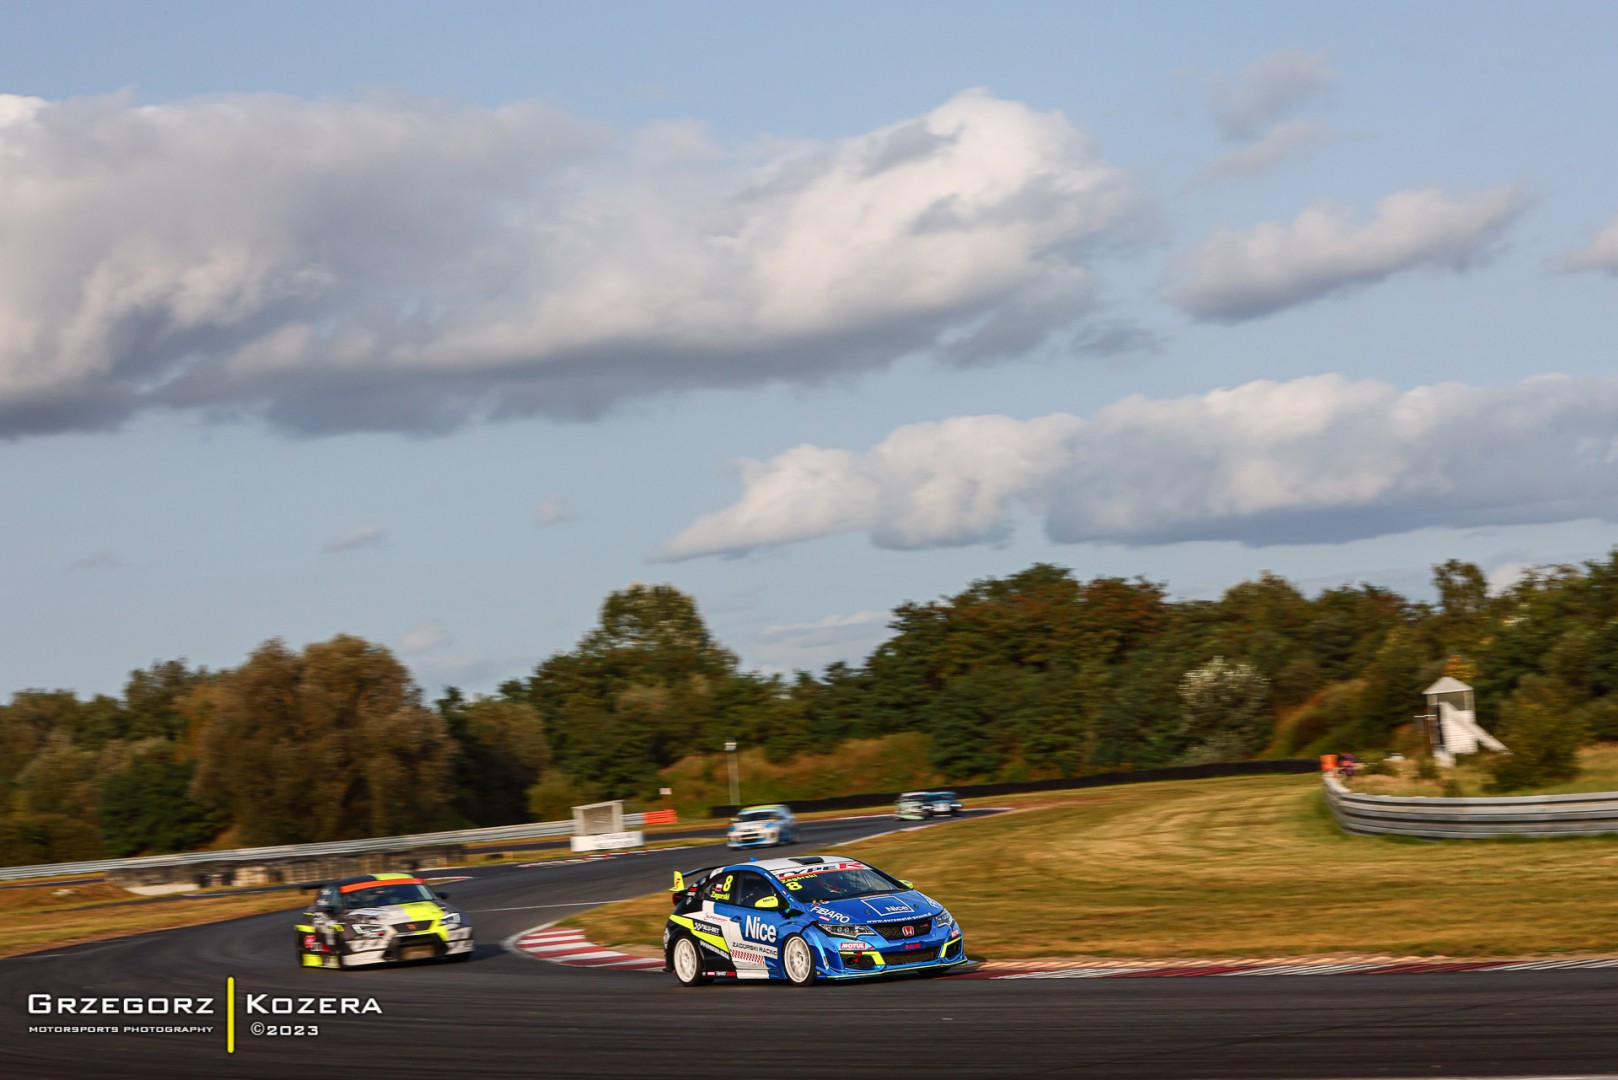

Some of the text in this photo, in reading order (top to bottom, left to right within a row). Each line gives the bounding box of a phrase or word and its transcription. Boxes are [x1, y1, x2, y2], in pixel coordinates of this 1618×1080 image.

[723, 875, 733, 892] 8
[785, 881, 803, 891] 8
[810, 906, 850, 923] FIBARO
[745, 914, 777, 943] Nice
[758, 946, 777, 957] RACING
